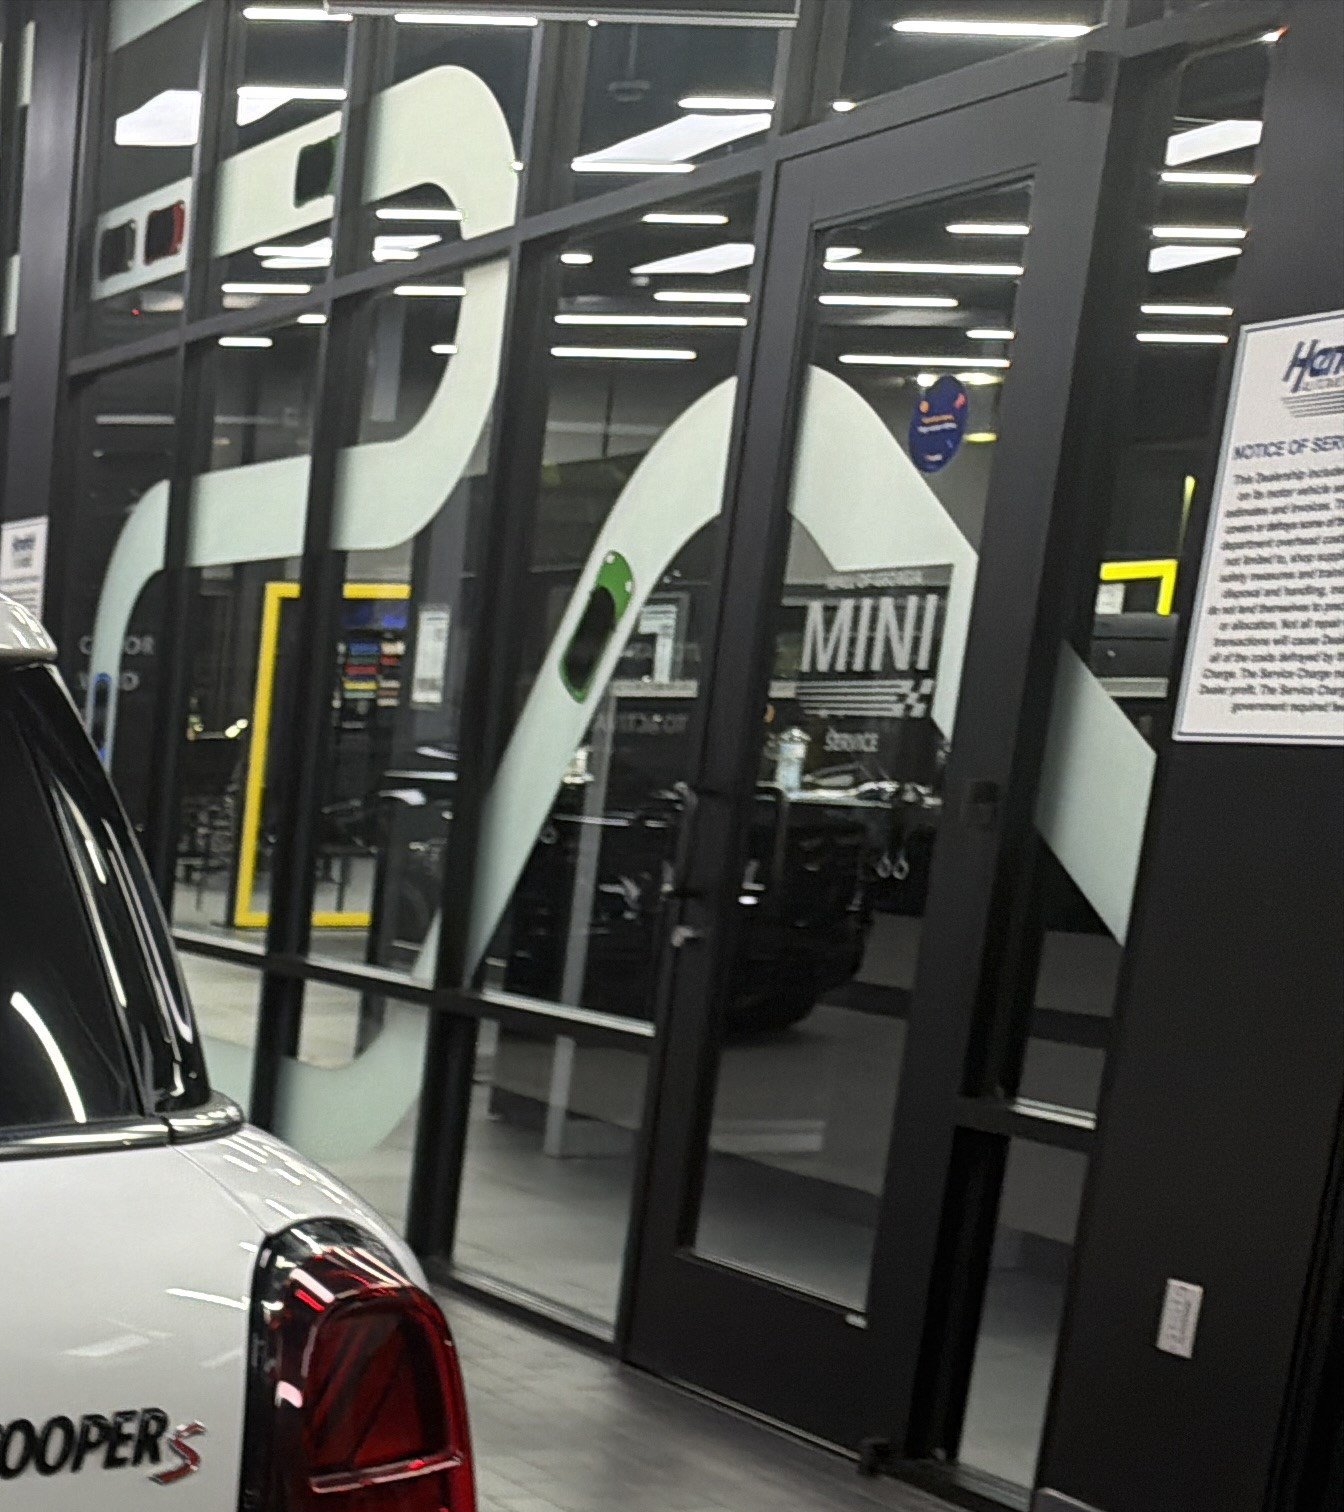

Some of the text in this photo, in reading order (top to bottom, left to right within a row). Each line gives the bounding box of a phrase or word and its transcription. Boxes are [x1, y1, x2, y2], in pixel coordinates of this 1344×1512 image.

[1233, 441, 1287, 460] NOTICE
[1287, 438, 1310, 455] OF
[801, 594, 939, 673] MINI
